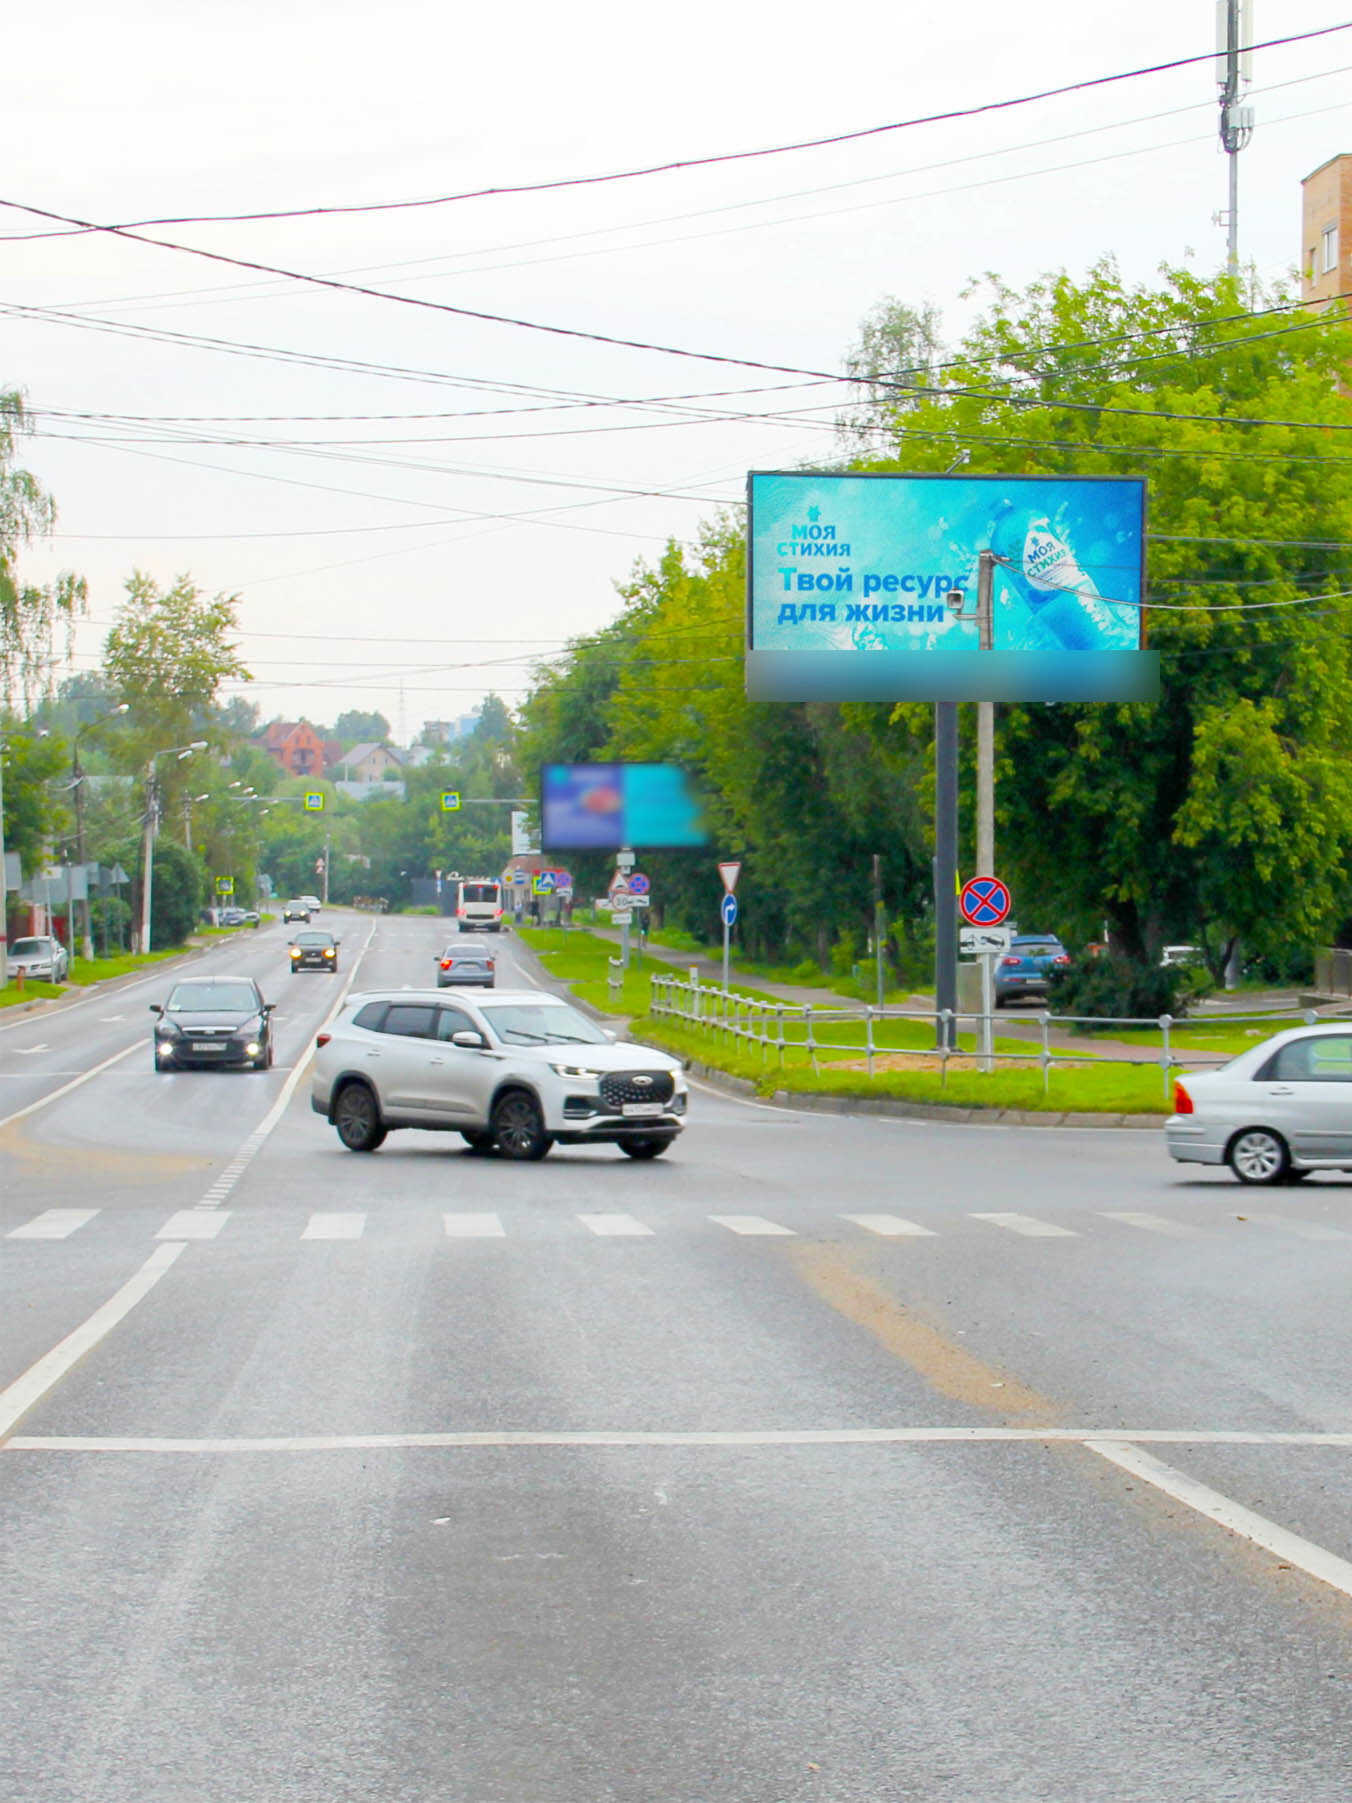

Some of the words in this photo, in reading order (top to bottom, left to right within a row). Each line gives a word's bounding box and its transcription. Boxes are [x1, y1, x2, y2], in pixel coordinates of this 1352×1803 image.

[791, 524, 836, 540] МОЯ
[776, 541, 851, 557] СТИХИЯ
[777, 567, 853, 592] Твой
[864, 573, 970, 599] ресурс
[777, 602, 836, 626] для
[844, 602, 945, 623] жизни
